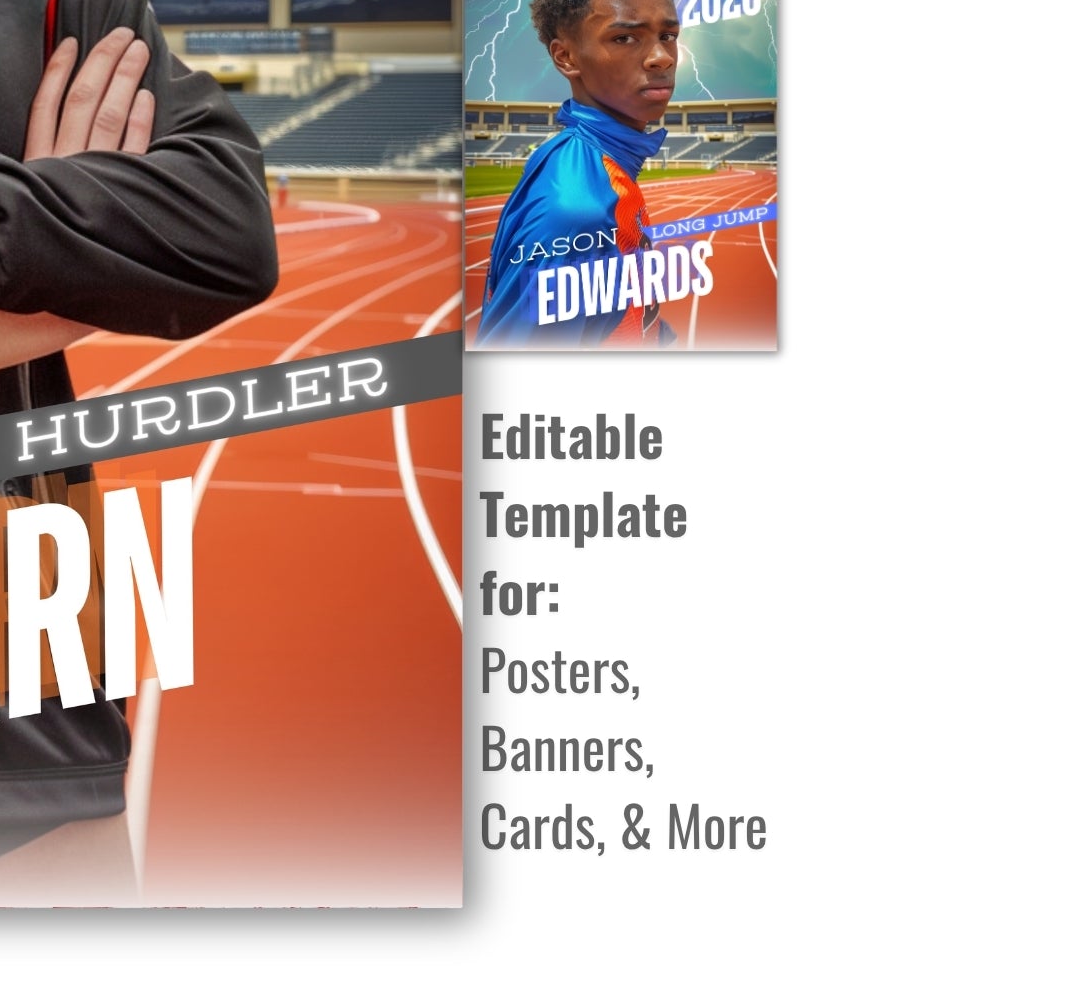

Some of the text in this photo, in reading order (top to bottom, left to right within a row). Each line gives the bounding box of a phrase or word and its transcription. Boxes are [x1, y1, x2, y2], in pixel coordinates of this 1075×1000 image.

[509, 227, 618, 264] JASON
[652, 207, 768, 239] LONG JUMP
[537, 240, 713, 326] EDWARDS
[16, 356, 391, 462] HURDLER
[481, 413, 663, 460] Editable
[479, 491, 687, 548] Template
[479, 570, 559, 616] for:
[481, 647, 640, 700] Posters,
[481, 725, 654, 779] Banners,
[481, 803, 767, 857] Cards, & More
